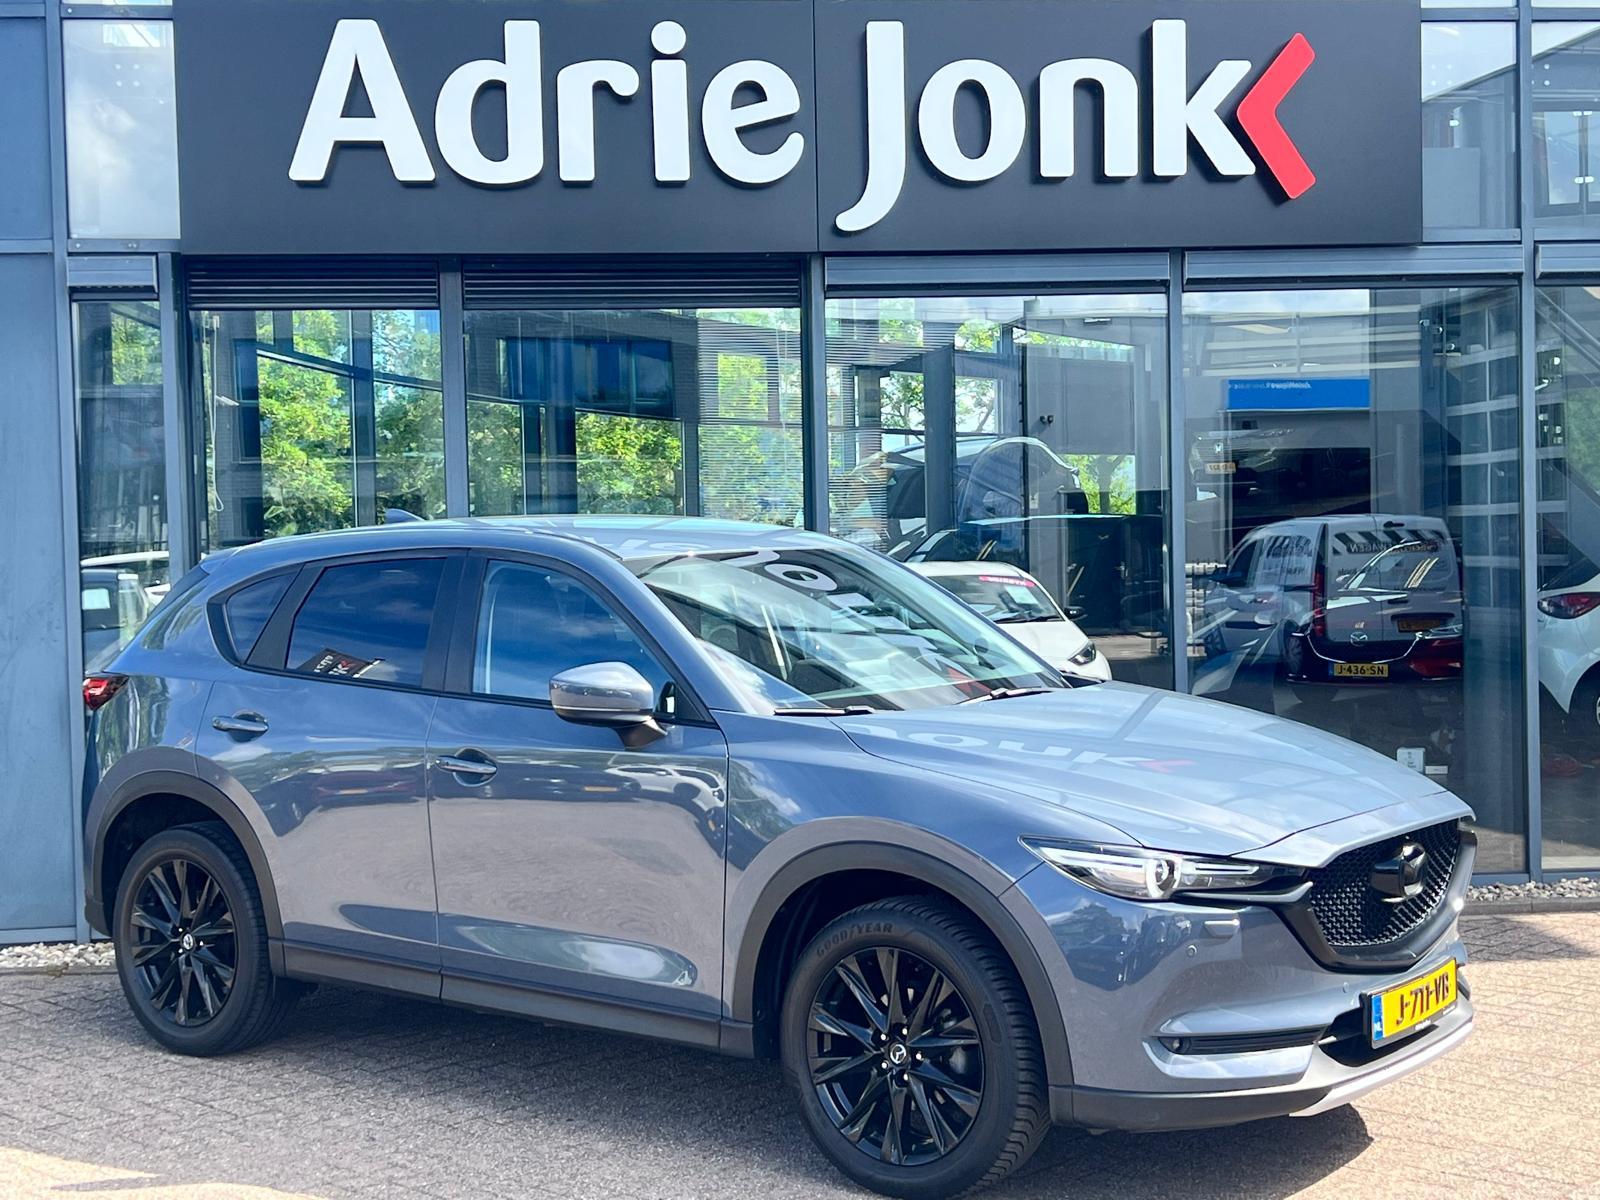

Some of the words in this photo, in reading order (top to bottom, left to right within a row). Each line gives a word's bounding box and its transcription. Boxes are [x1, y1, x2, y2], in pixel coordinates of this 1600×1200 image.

[288, 19, 804, 185] Adrie
[835, 19, 1256, 232] Jonk
[1337, 665, 1384, 675] J-436-SN
